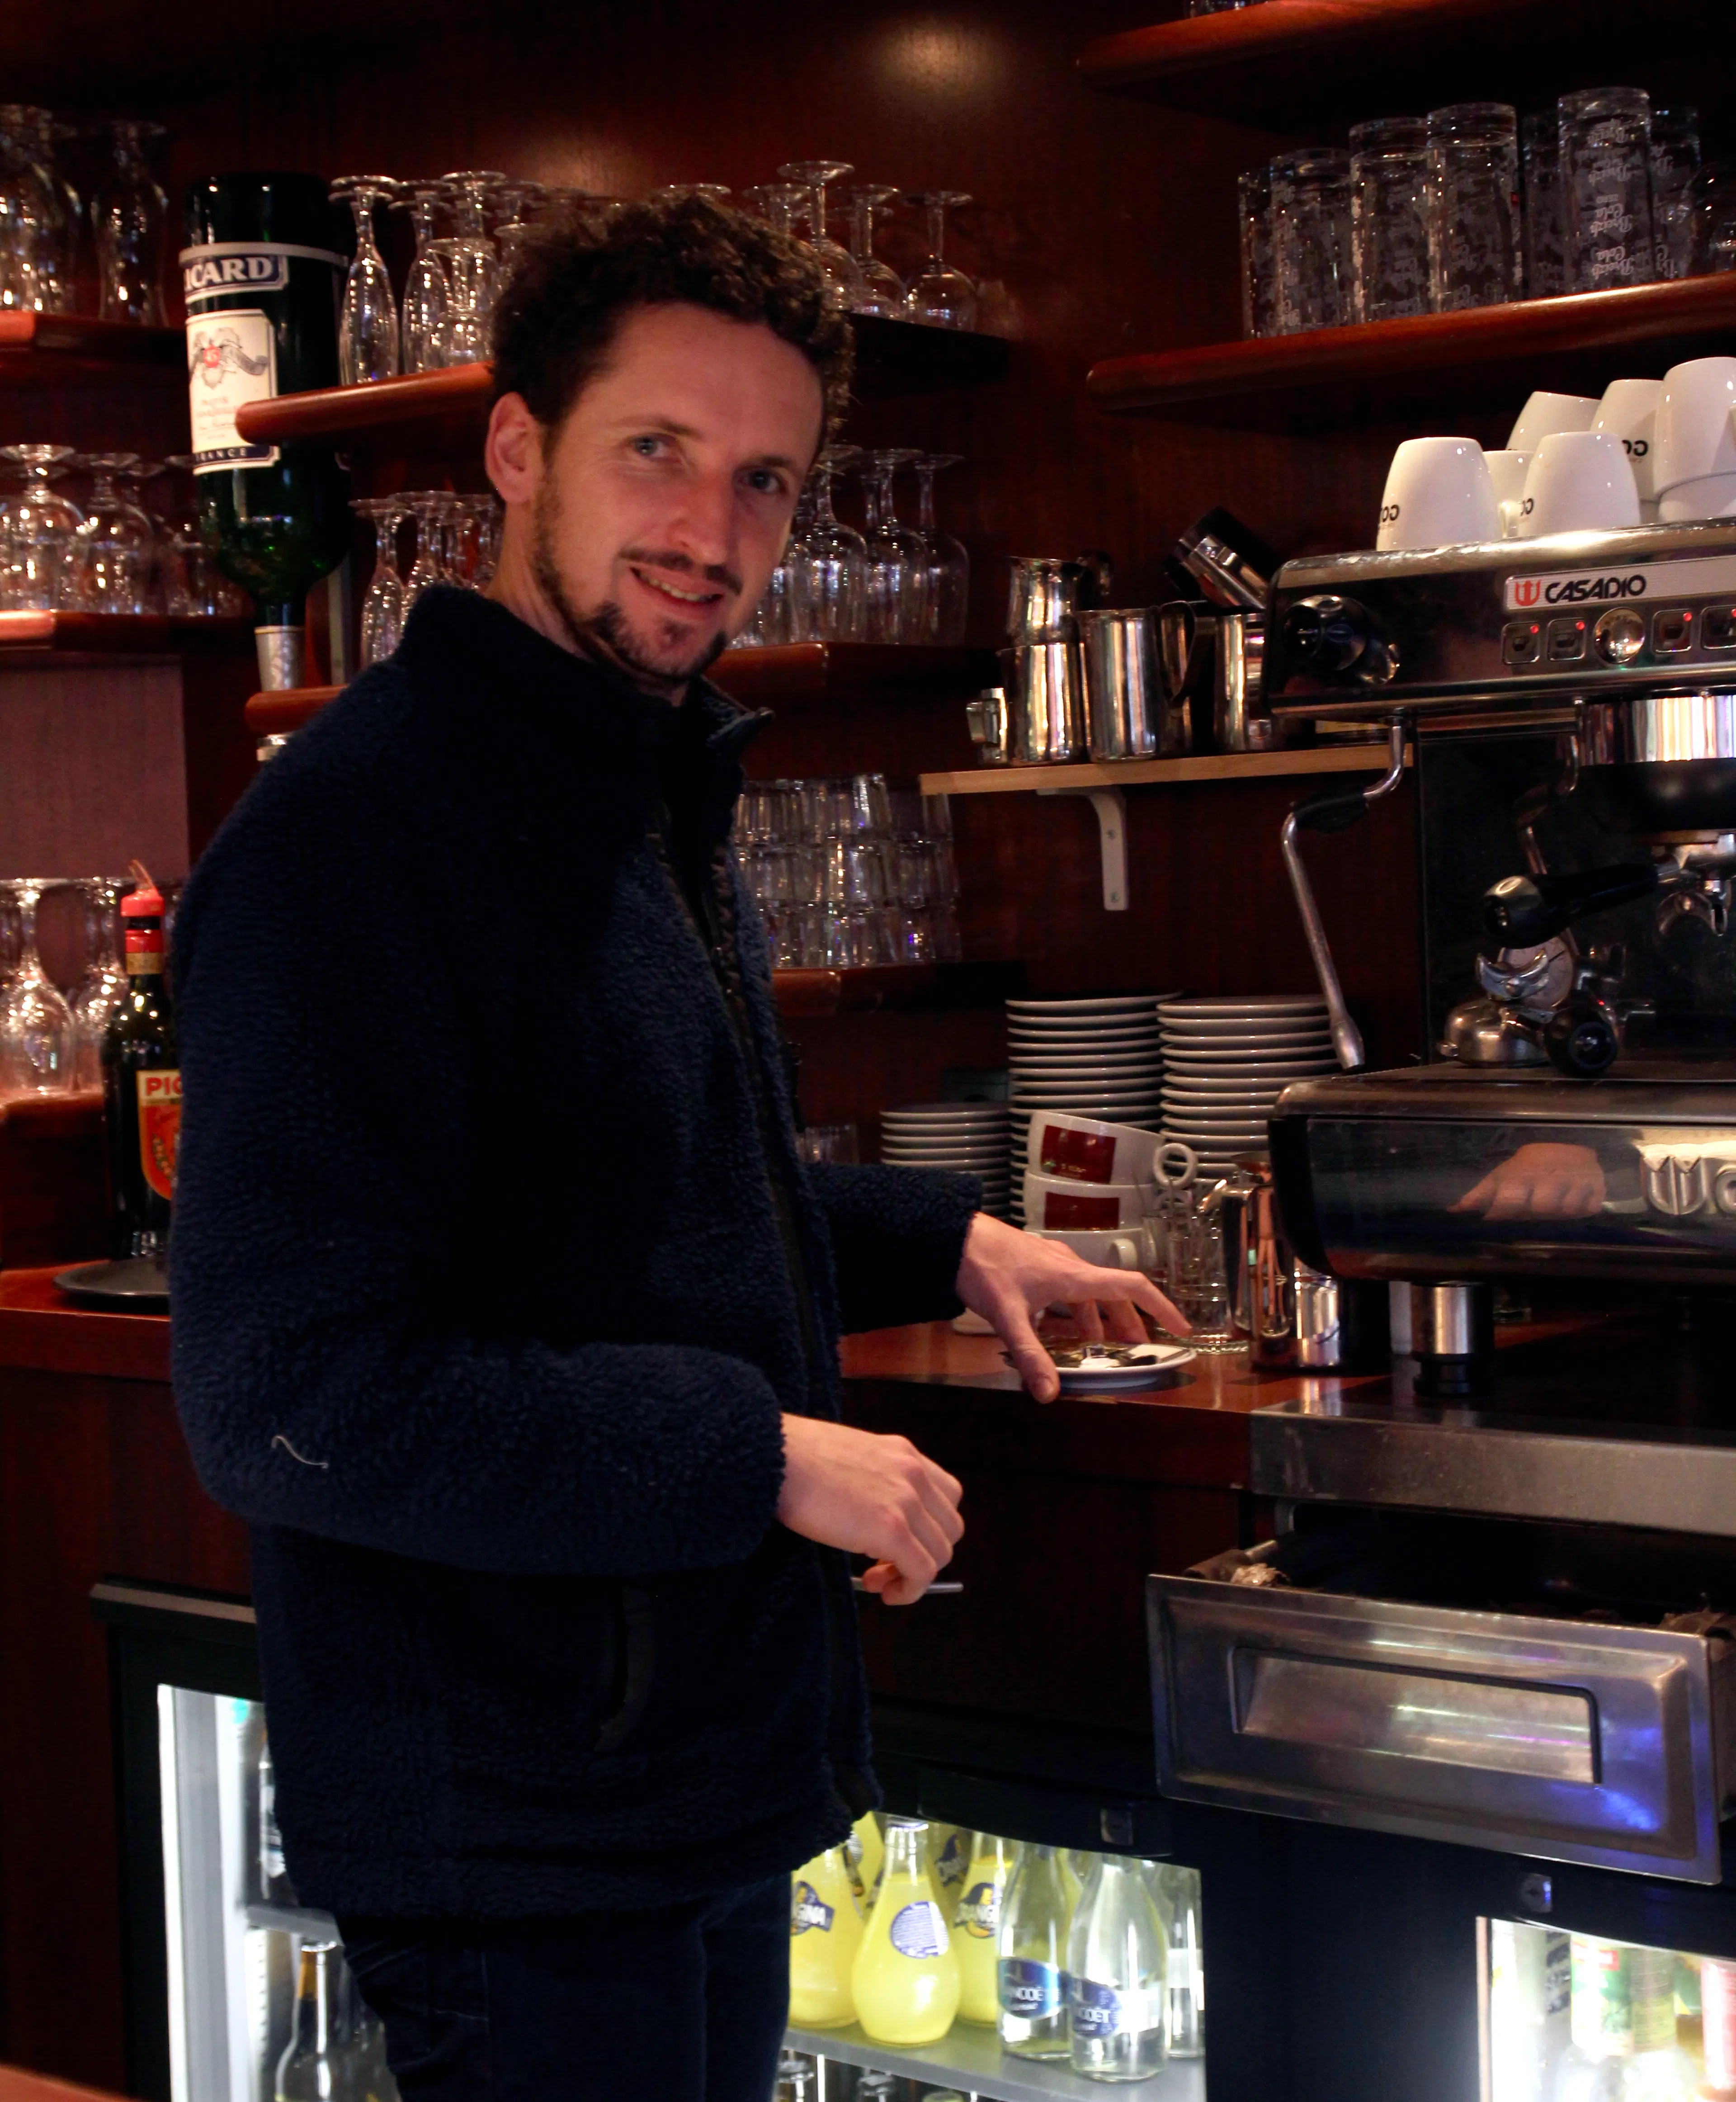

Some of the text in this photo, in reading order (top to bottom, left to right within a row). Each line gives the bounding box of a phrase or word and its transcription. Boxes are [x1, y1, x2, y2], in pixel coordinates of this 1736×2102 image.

[1595, 203, 1624, 218] Cola
[1596, 246, 1626, 262] Cola
[1545, 575, 1646, 604] CASADIO
